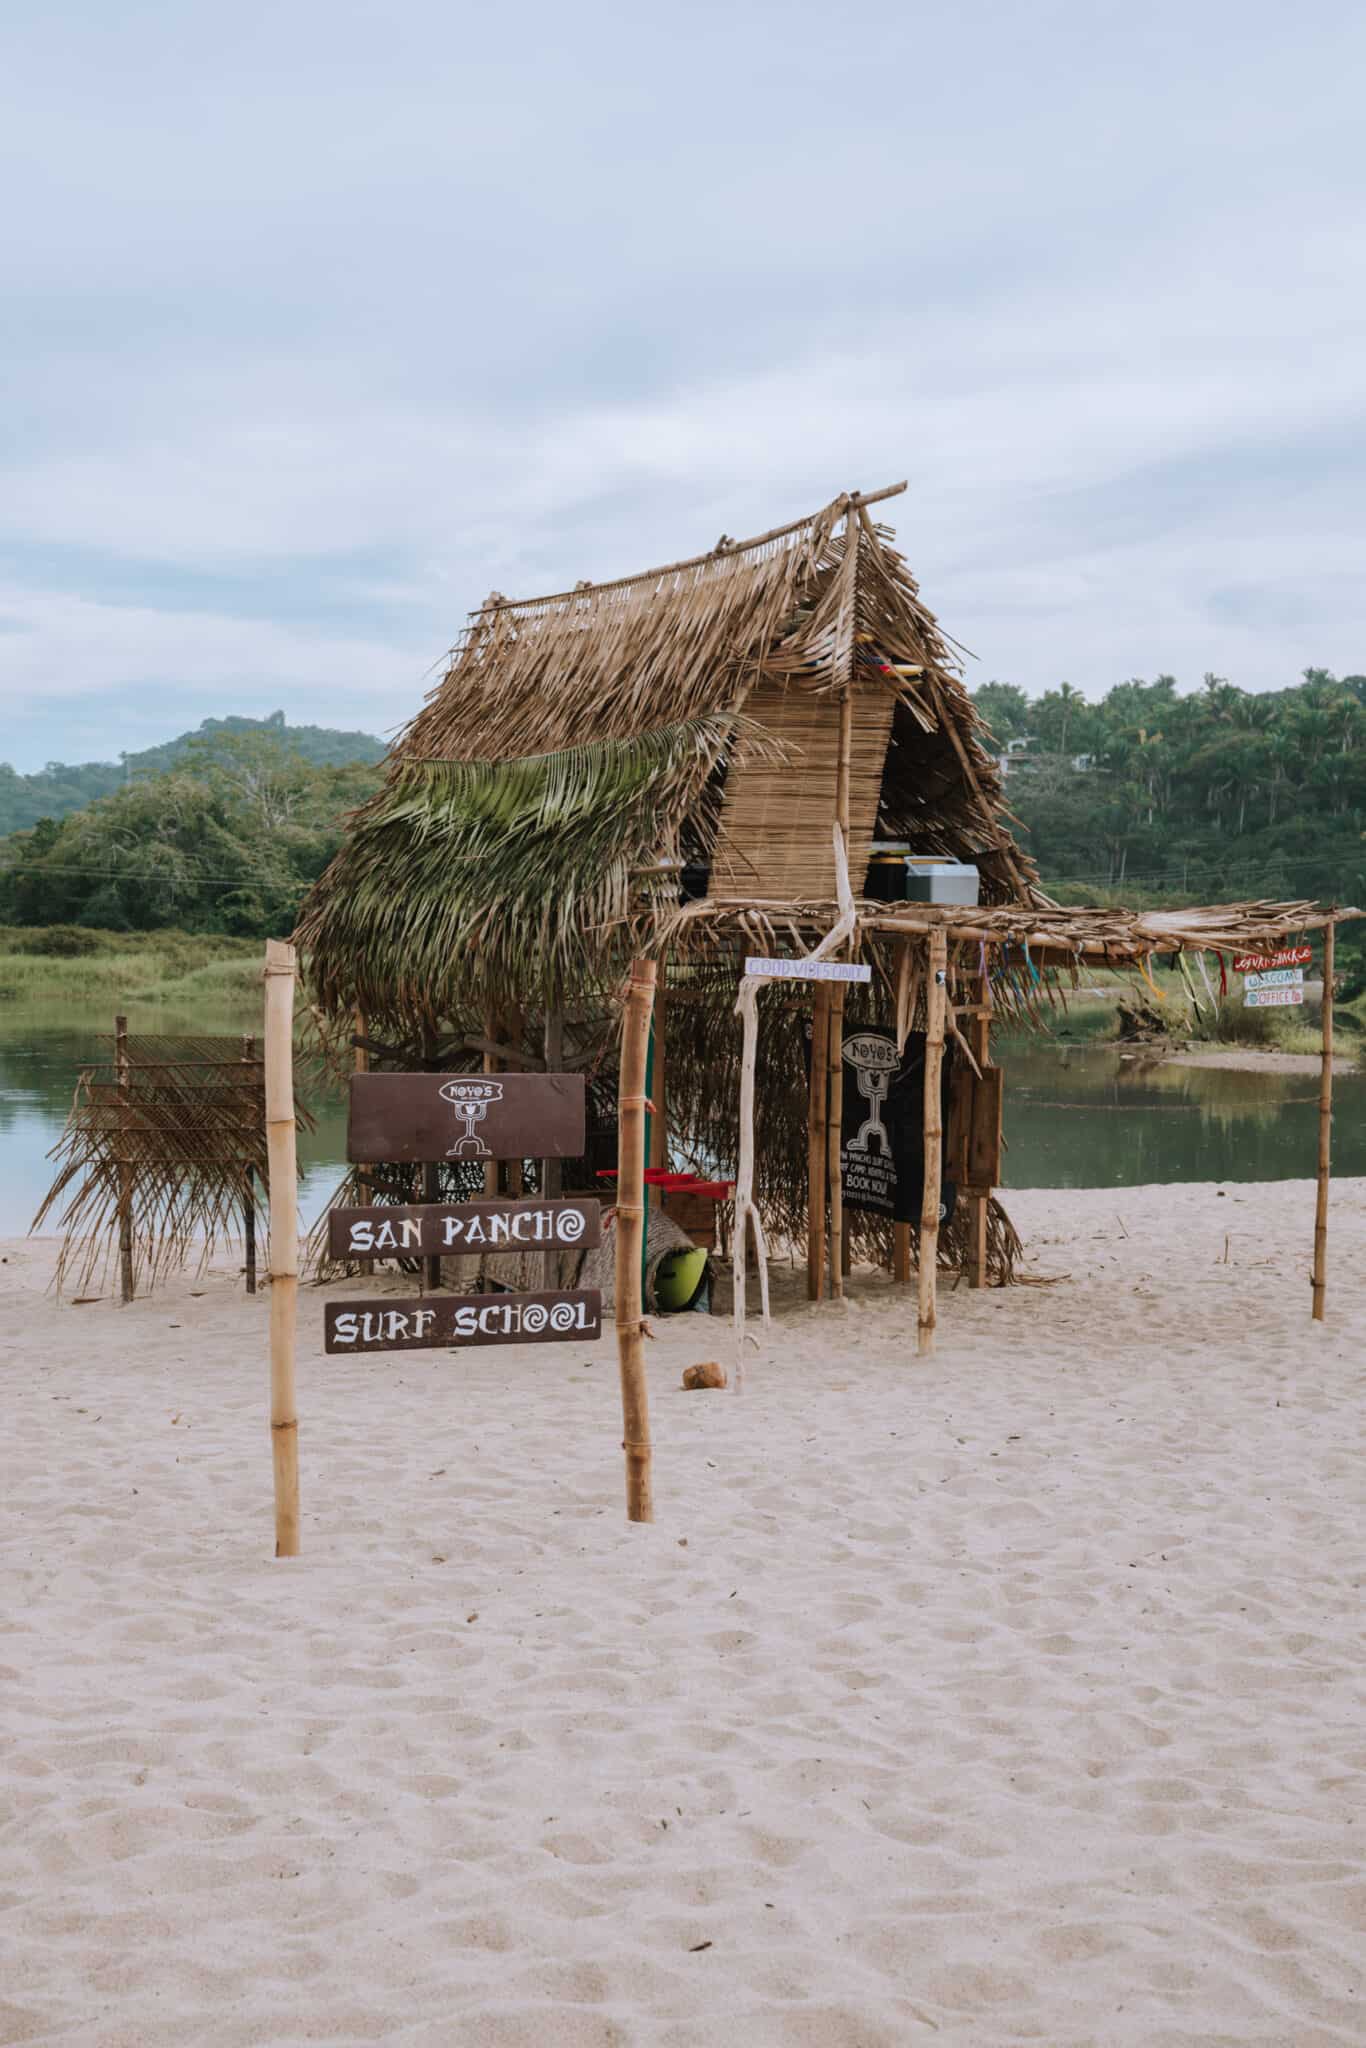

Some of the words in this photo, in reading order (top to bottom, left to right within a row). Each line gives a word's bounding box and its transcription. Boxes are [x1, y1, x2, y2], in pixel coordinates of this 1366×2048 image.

[1258, 991, 1290, 1005] OFFICE
[846, 1174, 871, 1191] BOOK
[350, 1217, 424, 1252] SAN
[441, 1208, 586, 1246] PANCHO
[333, 1309, 437, 1344] SURF
[453, 1301, 597, 1337] SCHOOL
